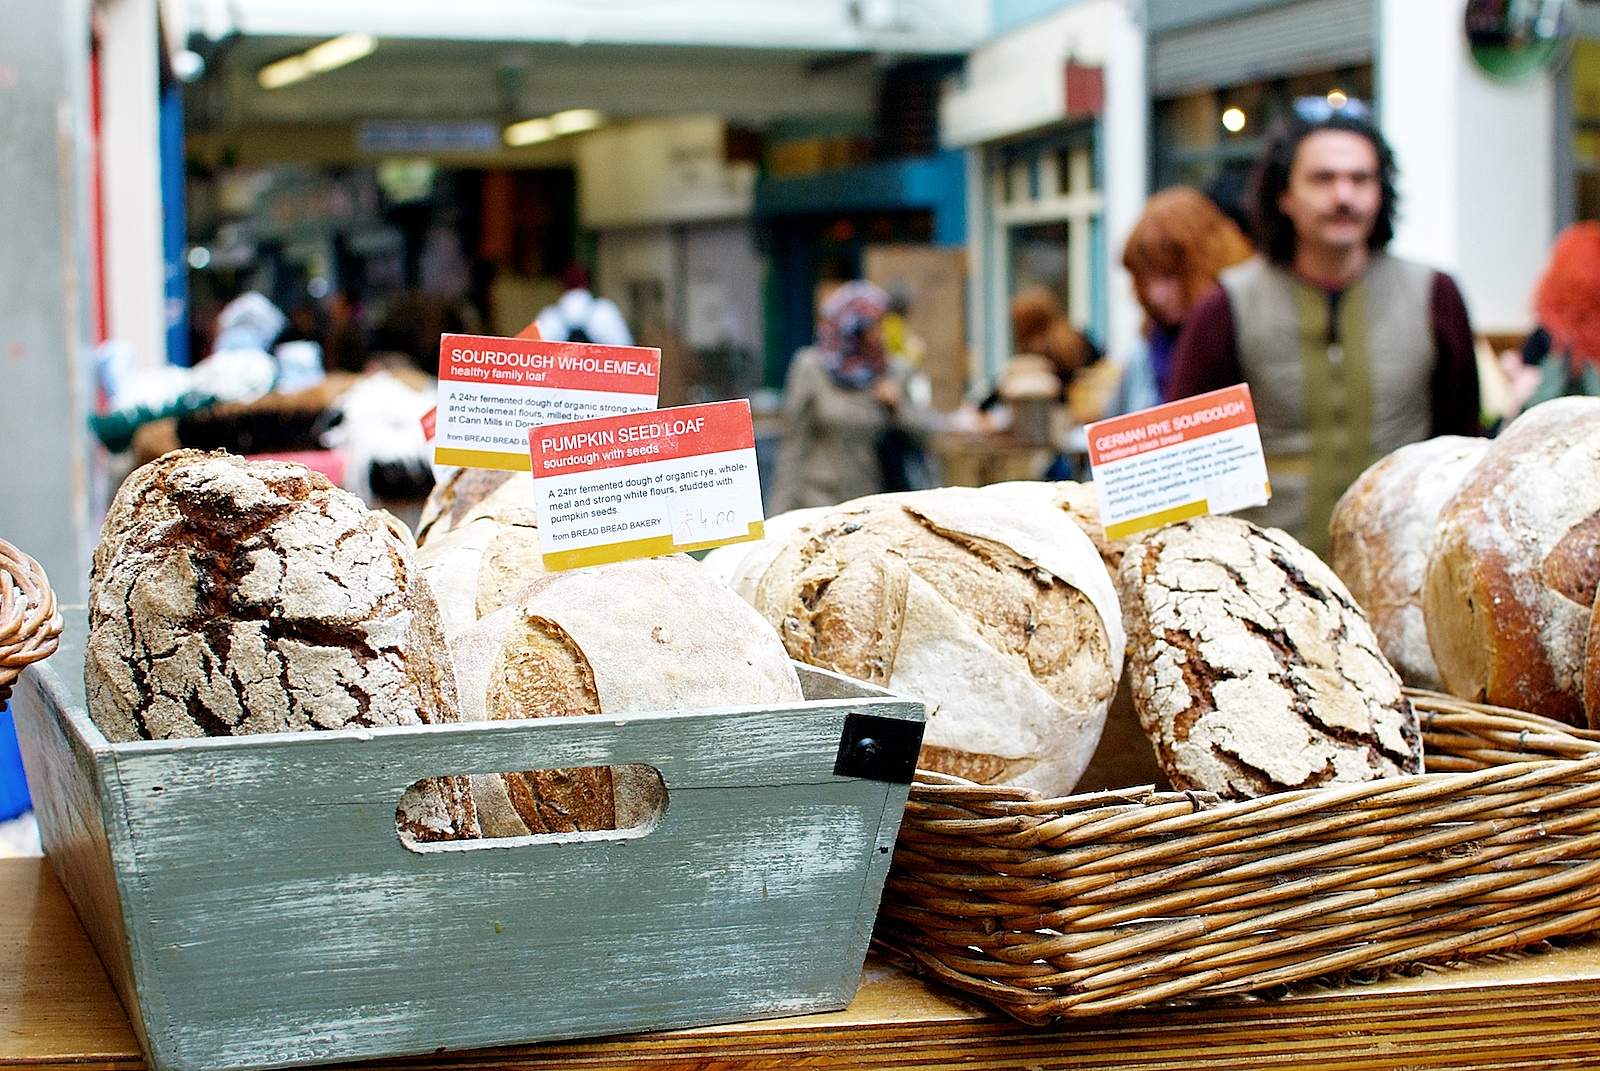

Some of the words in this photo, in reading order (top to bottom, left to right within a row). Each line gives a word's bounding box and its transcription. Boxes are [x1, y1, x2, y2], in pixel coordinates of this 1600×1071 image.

[451, 349, 554, 369] SOURDOUGH
[558, 356, 655, 377] WHOLEMEAL
[451, 365, 490, 379] healthy
[492, 367, 523, 380] family
[525, 370, 546, 382] loaf
[449, 404, 466, 412] and
[468, 406, 516, 416] wholemeal
[518, 409, 544, 419] flours,
[547, 411, 572, 420] milled
[458, 393, 478, 402] 24hr
[480, 394, 523, 405] fermented
[525, 398, 552, 409] dough
[554, 400, 562, 408] of
[564, 401, 597, 411] organic
[599, 404, 628, 414] strong
[458, 416, 482, 425] Cann
[484, 418, 503, 426] Mills
[1096, 427, 1146, 451] GERMAN
[1146, 419, 1172, 437] RYE
[1172, 402, 1245, 431] SOURDOUGH
[447, 433, 463, 441] from
[464, 434, 492, 443] BREAD
[492, 436, 520, 446] BREAD
[541, 430, 614, 454] PUMPKIN
[618, 423, 660, 443] SEED
[665, 417, 705, 436] LOAF
[543, 452, 600, 470] sourdough
[602, 447, 624, 462] with
[626, 444, 660, 458] seeds
[548, 490, 556, 498] A
[557, 487, 577, 498] 24hr
[579, 480, 624, 494] fermented
[625, 476, 653, 487] dough
[654, 474, 664, 482] of
[665, 470, 699, 482] organic
[700, 468, 717, 478] rye,
[718, 463, 748, 474] whole-
[549, 500, 572, 511] meal
[574, 498, 591, 508] and
[593, 494, 622, 504] strong
[623, 489, 648, 500] white
[650, 486, 677, 496] flours,
[679, 480, 714, 492] studded
[716, 477, 734, 486] with
[550, 511, 589, 525] pumpkin
[552, 533, 570, 541] from
[570, 528, 599, 538] BREAD
[600, 523, 628, 534] BREAD
[630, 518, 662, 530] BAKERY
